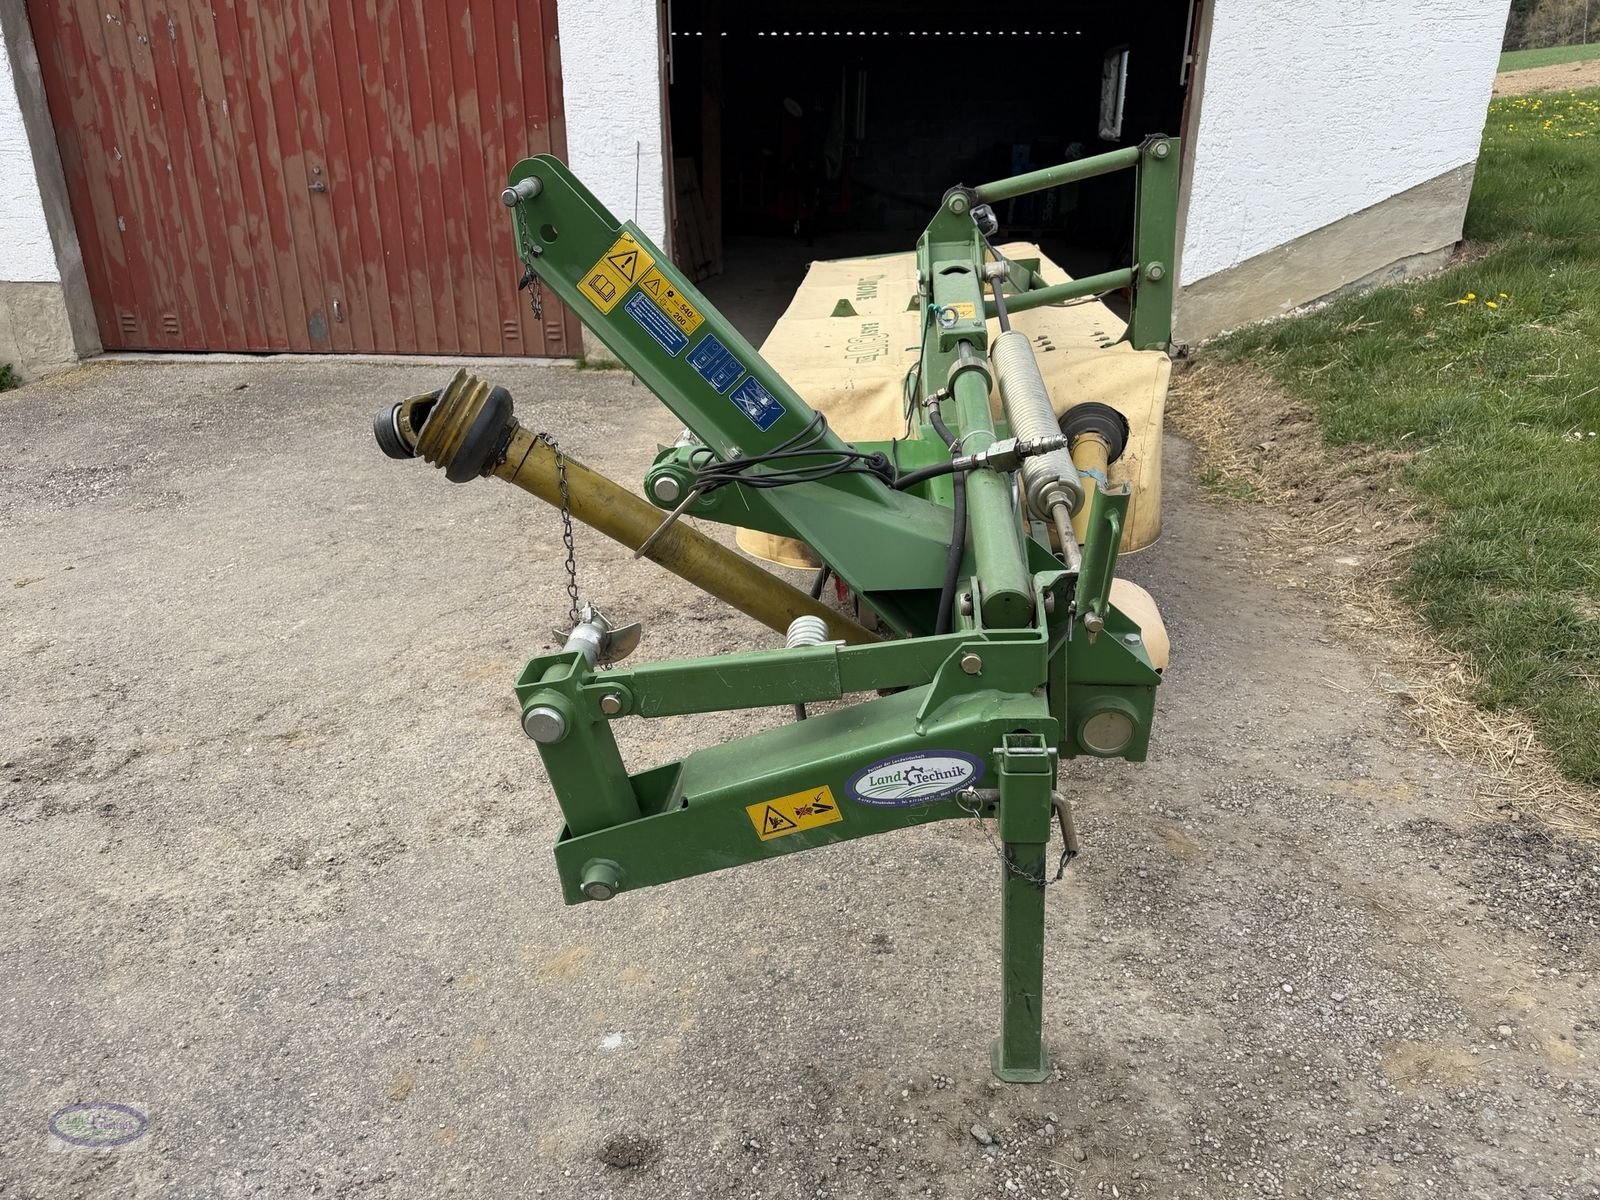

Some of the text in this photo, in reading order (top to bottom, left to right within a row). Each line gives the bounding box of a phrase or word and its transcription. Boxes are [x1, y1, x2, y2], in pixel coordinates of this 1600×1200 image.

[673, 312, 687, 326] 200
[869, 770, 902, 787] Land
[914, 765, 966, 784] Technik
